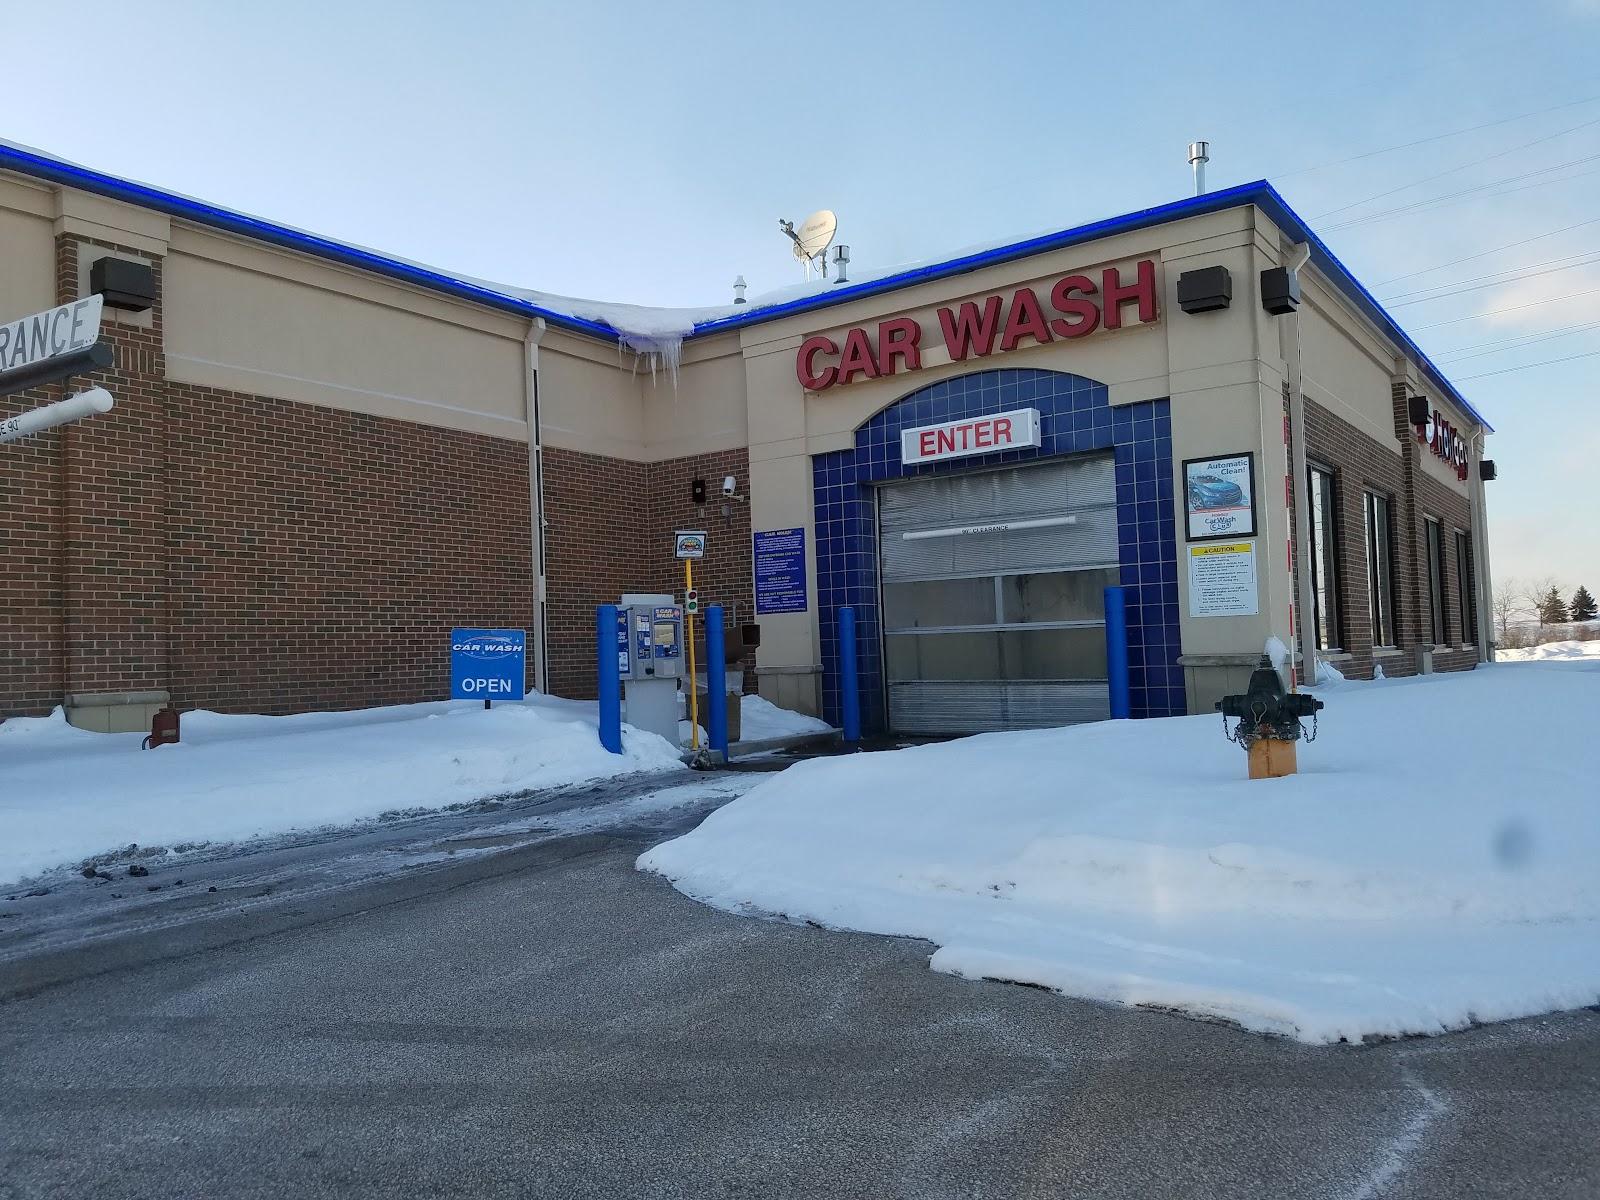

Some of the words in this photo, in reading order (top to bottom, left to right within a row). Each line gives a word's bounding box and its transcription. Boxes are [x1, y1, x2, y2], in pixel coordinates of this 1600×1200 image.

[796, 316, 922, 391] CAR
[937, 260, 1157, 361] WASH
[919, 418, 1012, 456] ENTER
[1207, 460, 1248, 470] Automatic
[1220, 467, 1246, 476] Clean!
[972, 524, 1009, 534] CLEARANCE
[1208, 546, 1235, 554] CAUTION
[484, 644, 523, 652] WASH
[462, 678, 511, 692] OPEN
